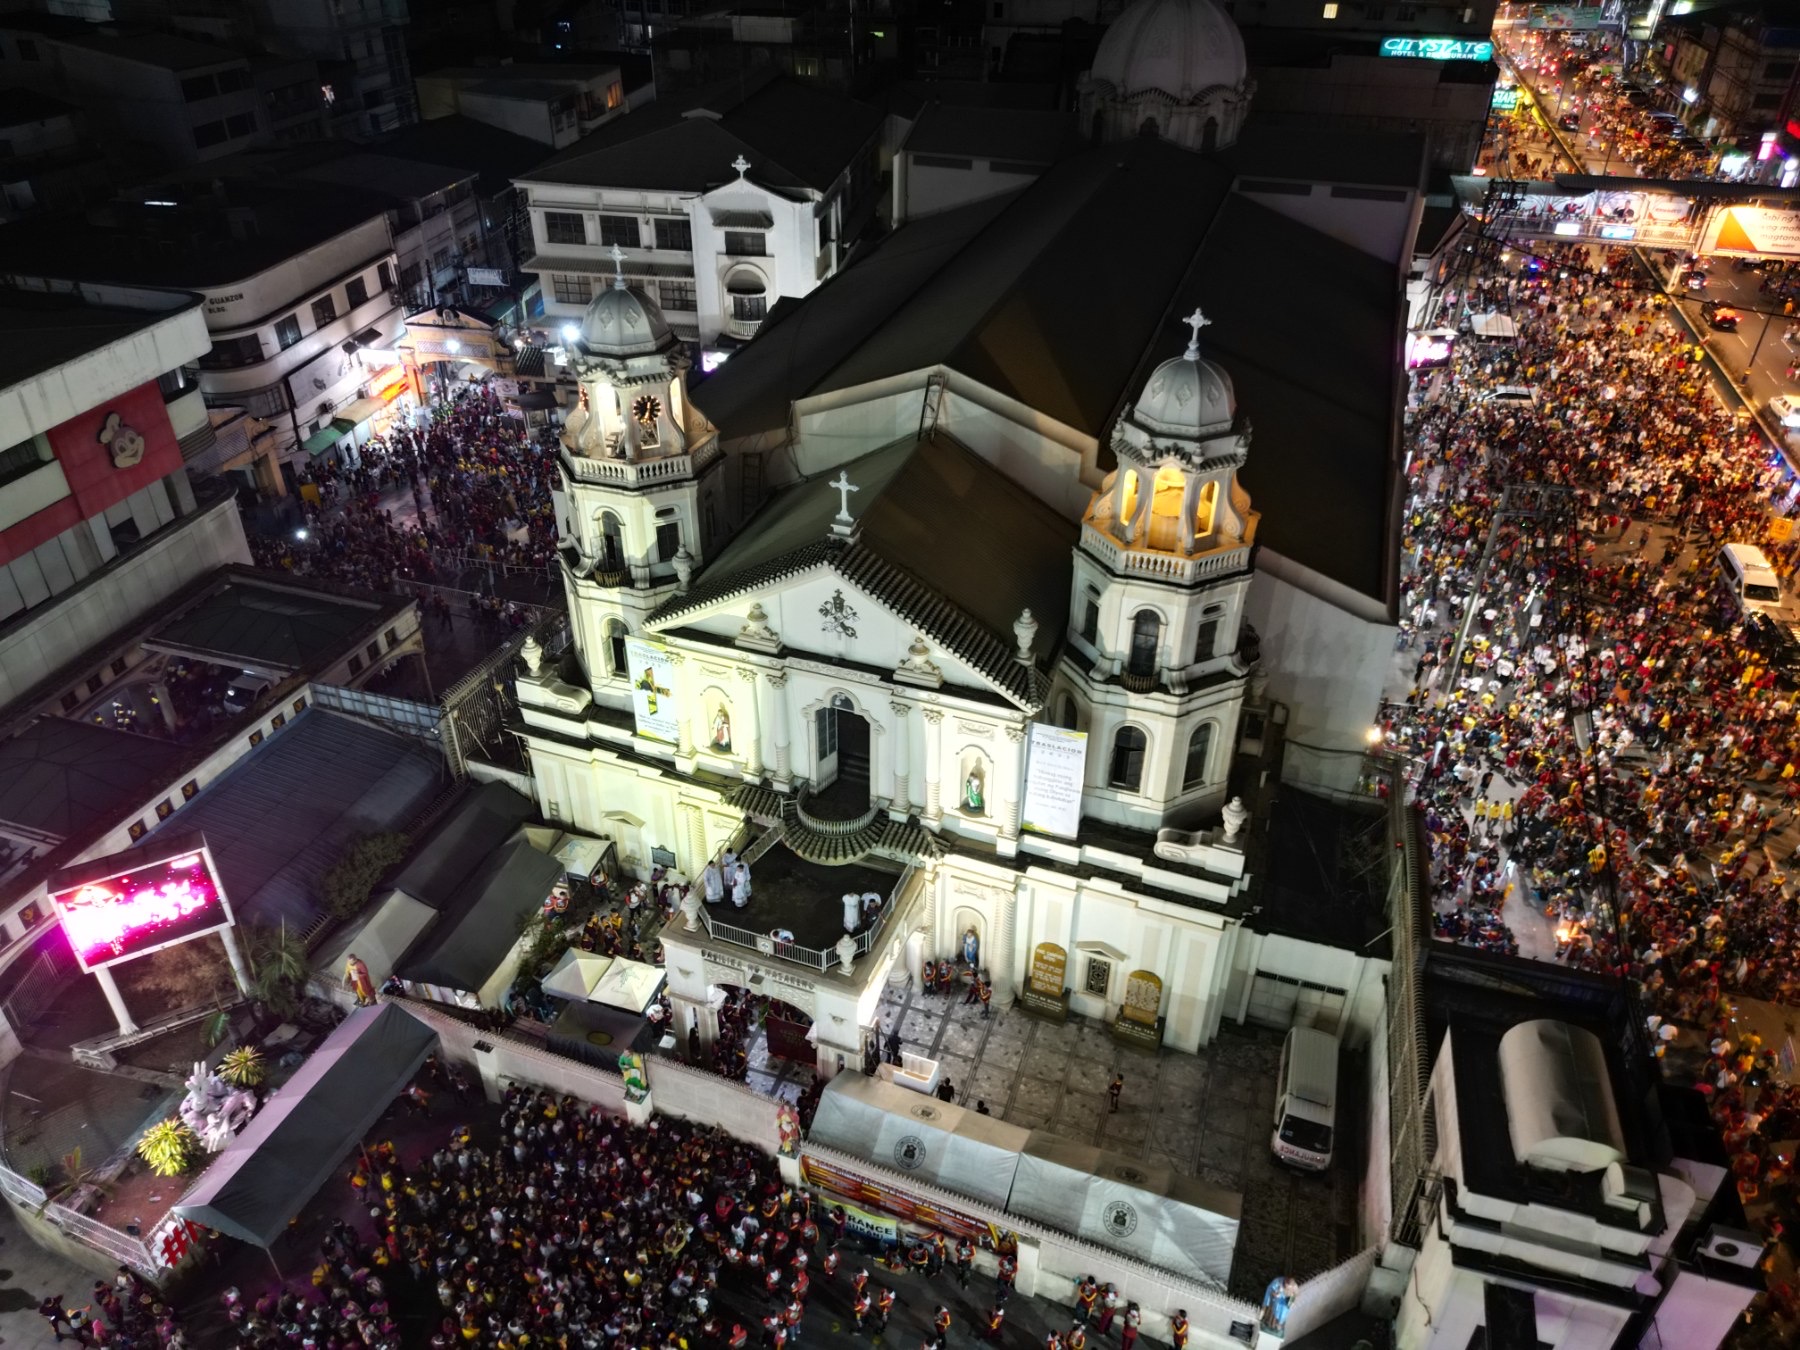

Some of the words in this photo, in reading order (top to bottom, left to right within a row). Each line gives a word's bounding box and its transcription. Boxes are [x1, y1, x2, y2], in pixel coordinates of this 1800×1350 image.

[1384, 38, 1490, 54] CITYSTATE
[1426, 52, 1478, 60] REURANT
[209, 293, 244, 305] GUANZON
